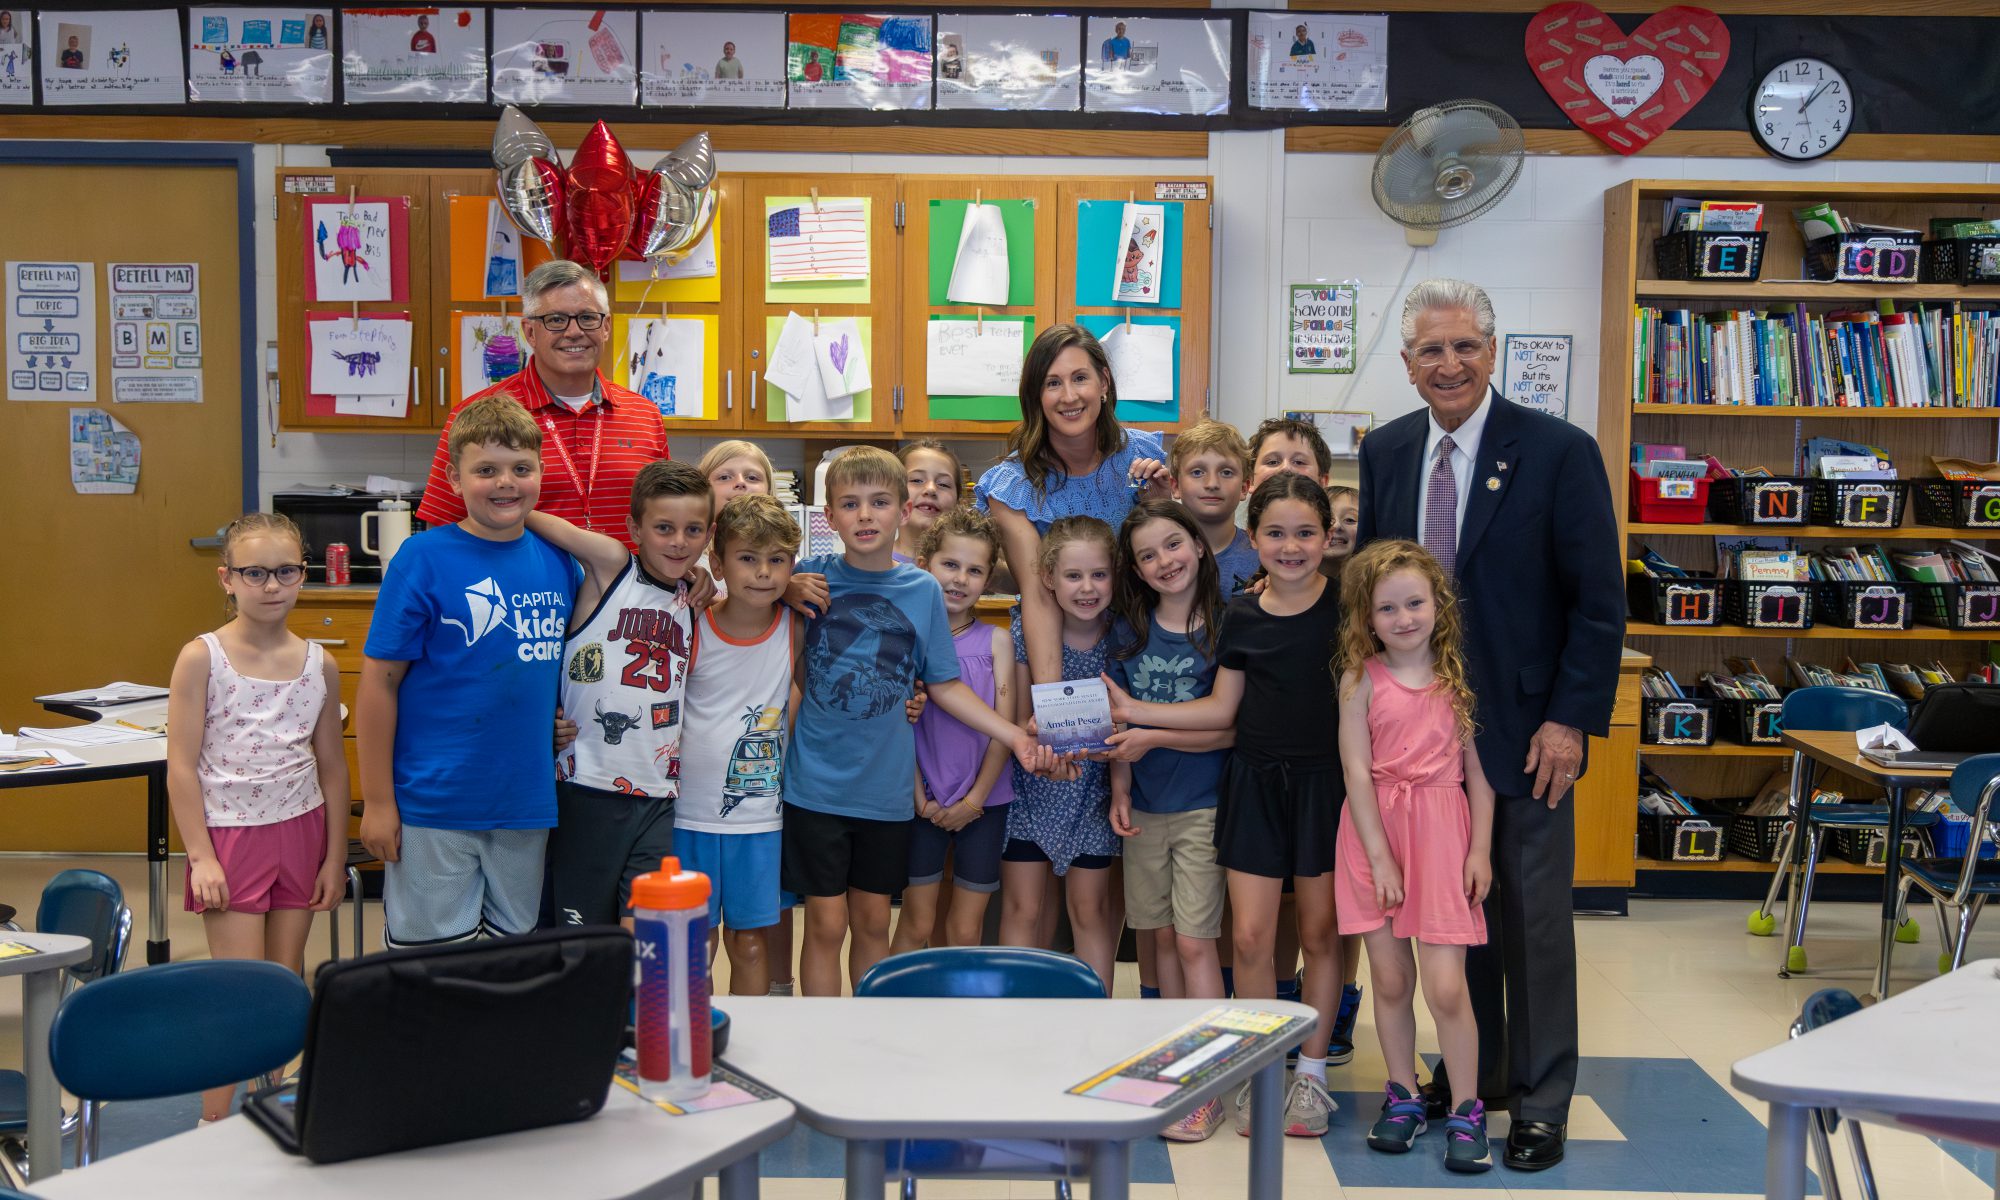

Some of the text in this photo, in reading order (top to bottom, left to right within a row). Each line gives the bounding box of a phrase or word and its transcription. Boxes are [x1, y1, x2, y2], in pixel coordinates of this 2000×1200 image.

[1795, 62, 1810, 75] 12
[1818, 68, 1824, 80] 1
[1778, 70, 1789, 82] 11
[1832, 81, 1840, 94] 2
[1759, 105, 1767, 117] 9
[1838, 100, 1847, 113] 3
[1765, 123, 1774, 135] 8
[1833, 120, 1841, 131] 4
[1781, 138, 1790, 150] 7
[1800, 141, 1808, 153] 6
[1818, 136, 1826, 148] 5
[1719, 247, 1737, 270] E
[1856, 249, 1873, 273] C
[1890, 252, 1906, 275] D
[21, 270, 77, 281] RETELL MAT
[117, 268, 191, 284] RETELL MAT
[35, 301, 62, 311] TOPIC
[1295, 305, 1352, 317] have only
[29, 336, 70, 346] BIG IDEA
[123, 331, 133, 345] B
[151, 331, 166, 345] M
[184, 331, 193, 345] E
[1512, 341, 1565, 350] It's OKAY to
[1515, 351, 1535, 361] NOT
[1522, 371, 1551, 380] But It's
[1513, 382, 1558, 392] NOT OKAY
[1521, 393, 1551, 404] to NOT
[1768, 492, 1788, 516] N
[1861, 497, 1878, 520] F
[1985, 498, 2000, 520] G
[512, 591, 565, 608] CAPITAL
[1681, 595, 1700, 619] H
[1777, 597, 1785, 621] I
[1871, 599, 1889, 622] J
[1980, 597, 1997, 621] J
[514, 609, 565, 640] kids
[517, 641, 561, 662] care
[621, 642, 671, 693] 23
[1046, 717, 1101, 729] Amelia Pesez
[1674, 715, 1692, 737] K
[1768, 714, 1782, 736] K
[1689, 832, 1704, 854] L
